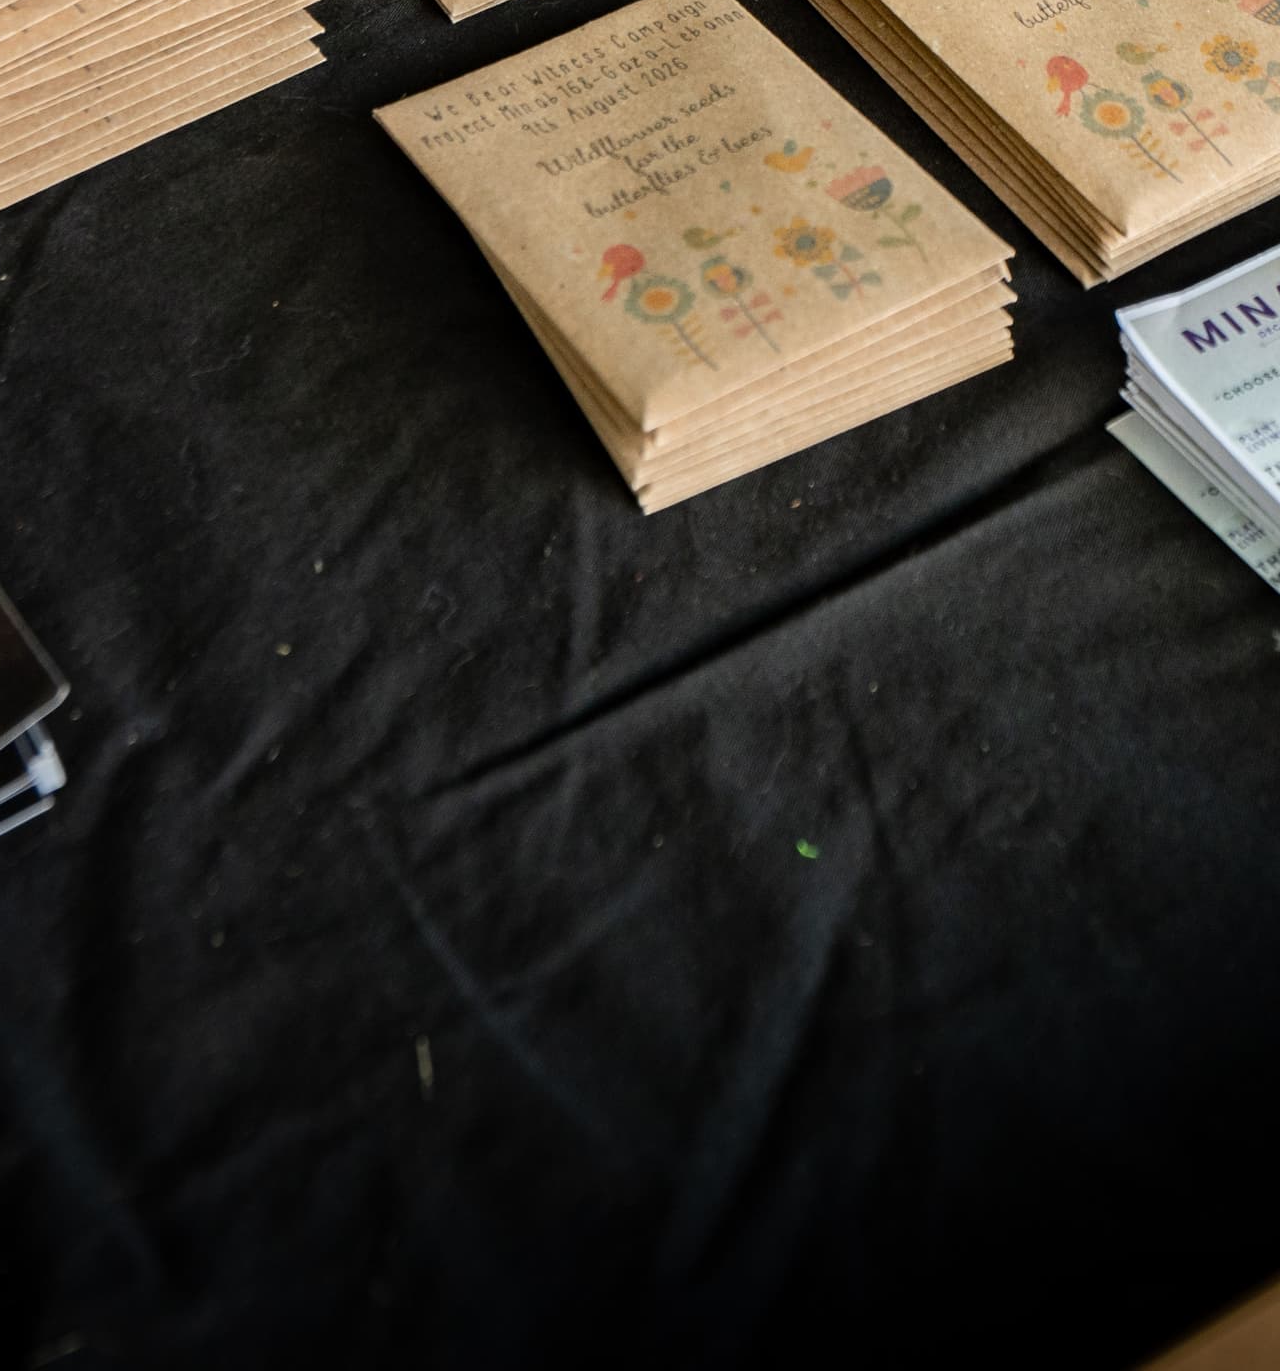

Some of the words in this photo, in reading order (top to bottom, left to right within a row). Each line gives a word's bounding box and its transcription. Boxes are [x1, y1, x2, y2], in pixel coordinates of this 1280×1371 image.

[537, 117, 674, 176] Wildflower
[679, 84, 734, 115] seeds
[586, 166, 692, 218] butterflies
[697, 148, 718, 165] &
[719, 130, 770, 152] bees
[623, 151, 661, 176] for
[662, 133, 699, 152] the
